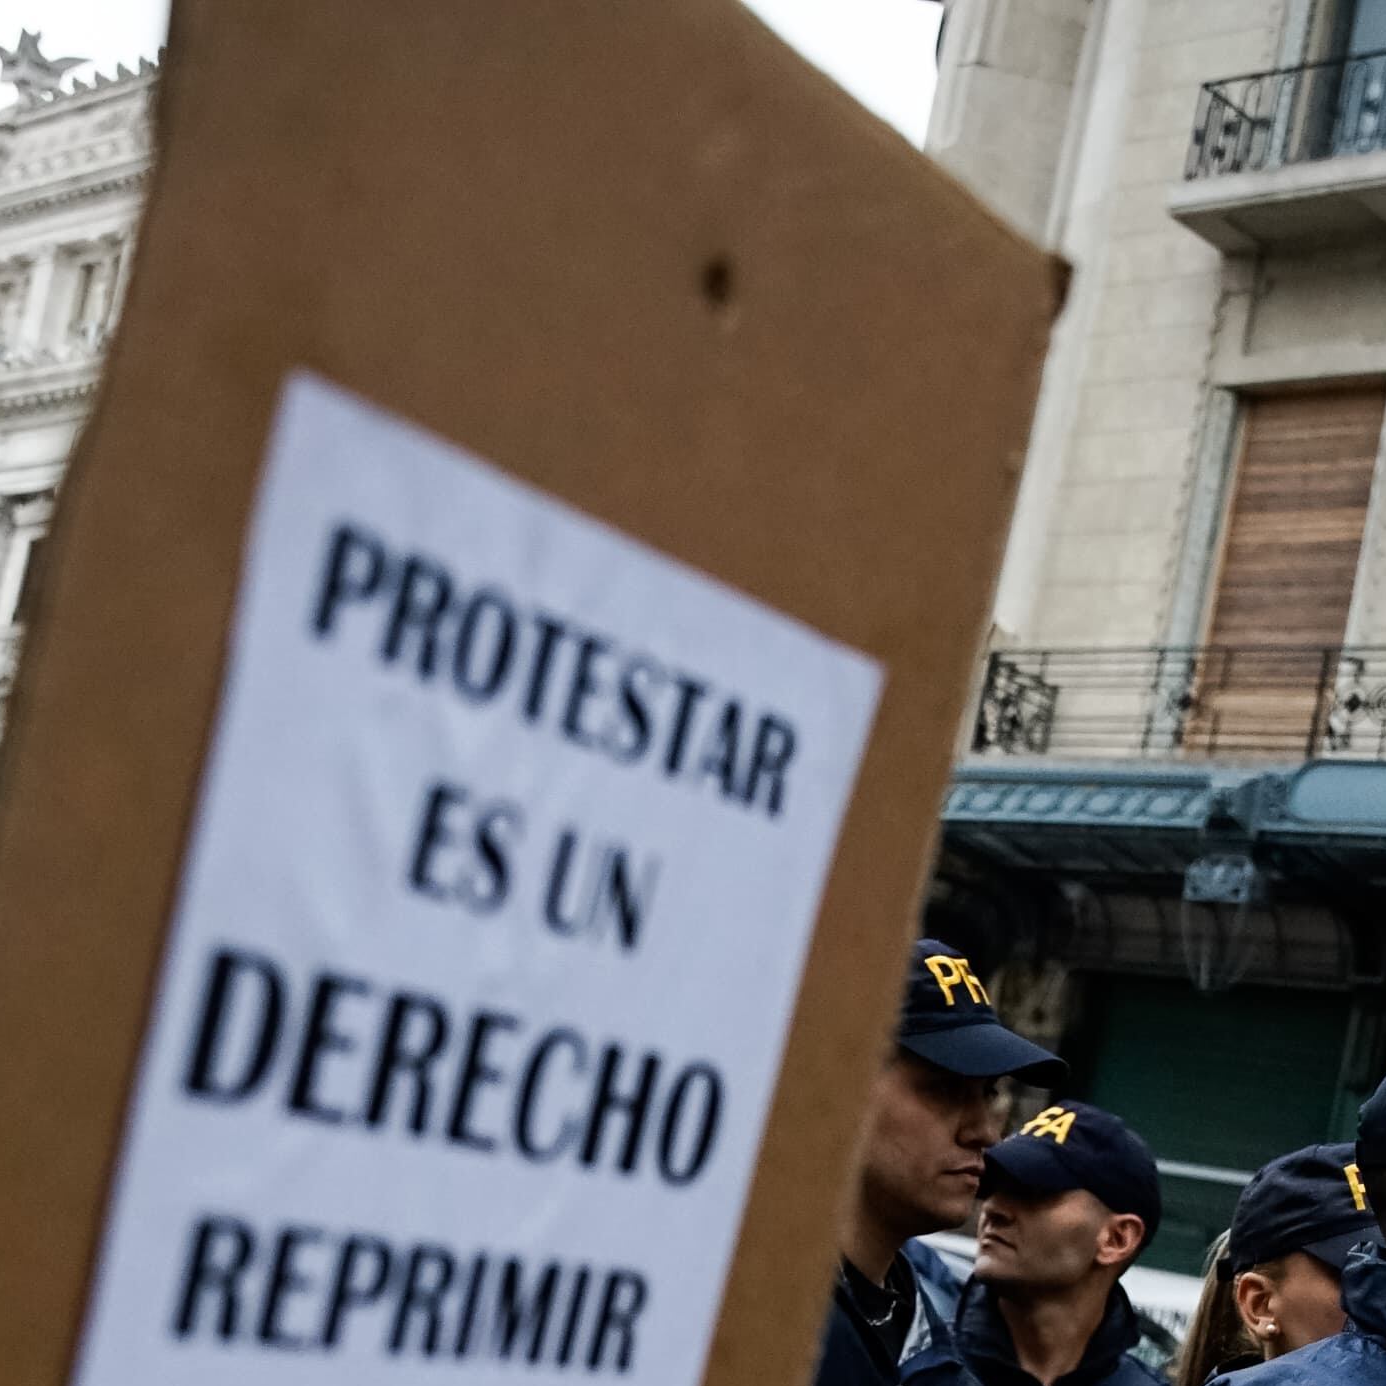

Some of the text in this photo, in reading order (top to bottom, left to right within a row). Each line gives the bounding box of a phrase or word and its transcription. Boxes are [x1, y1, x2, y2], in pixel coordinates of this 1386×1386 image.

[306, 522, 801, 822] PROTESTAR
[405, 782, 659, 957] ES UN
[180, 943, 728, 1188] DERECHO
[169, 1212, 652, 1375] REPRIMIR
